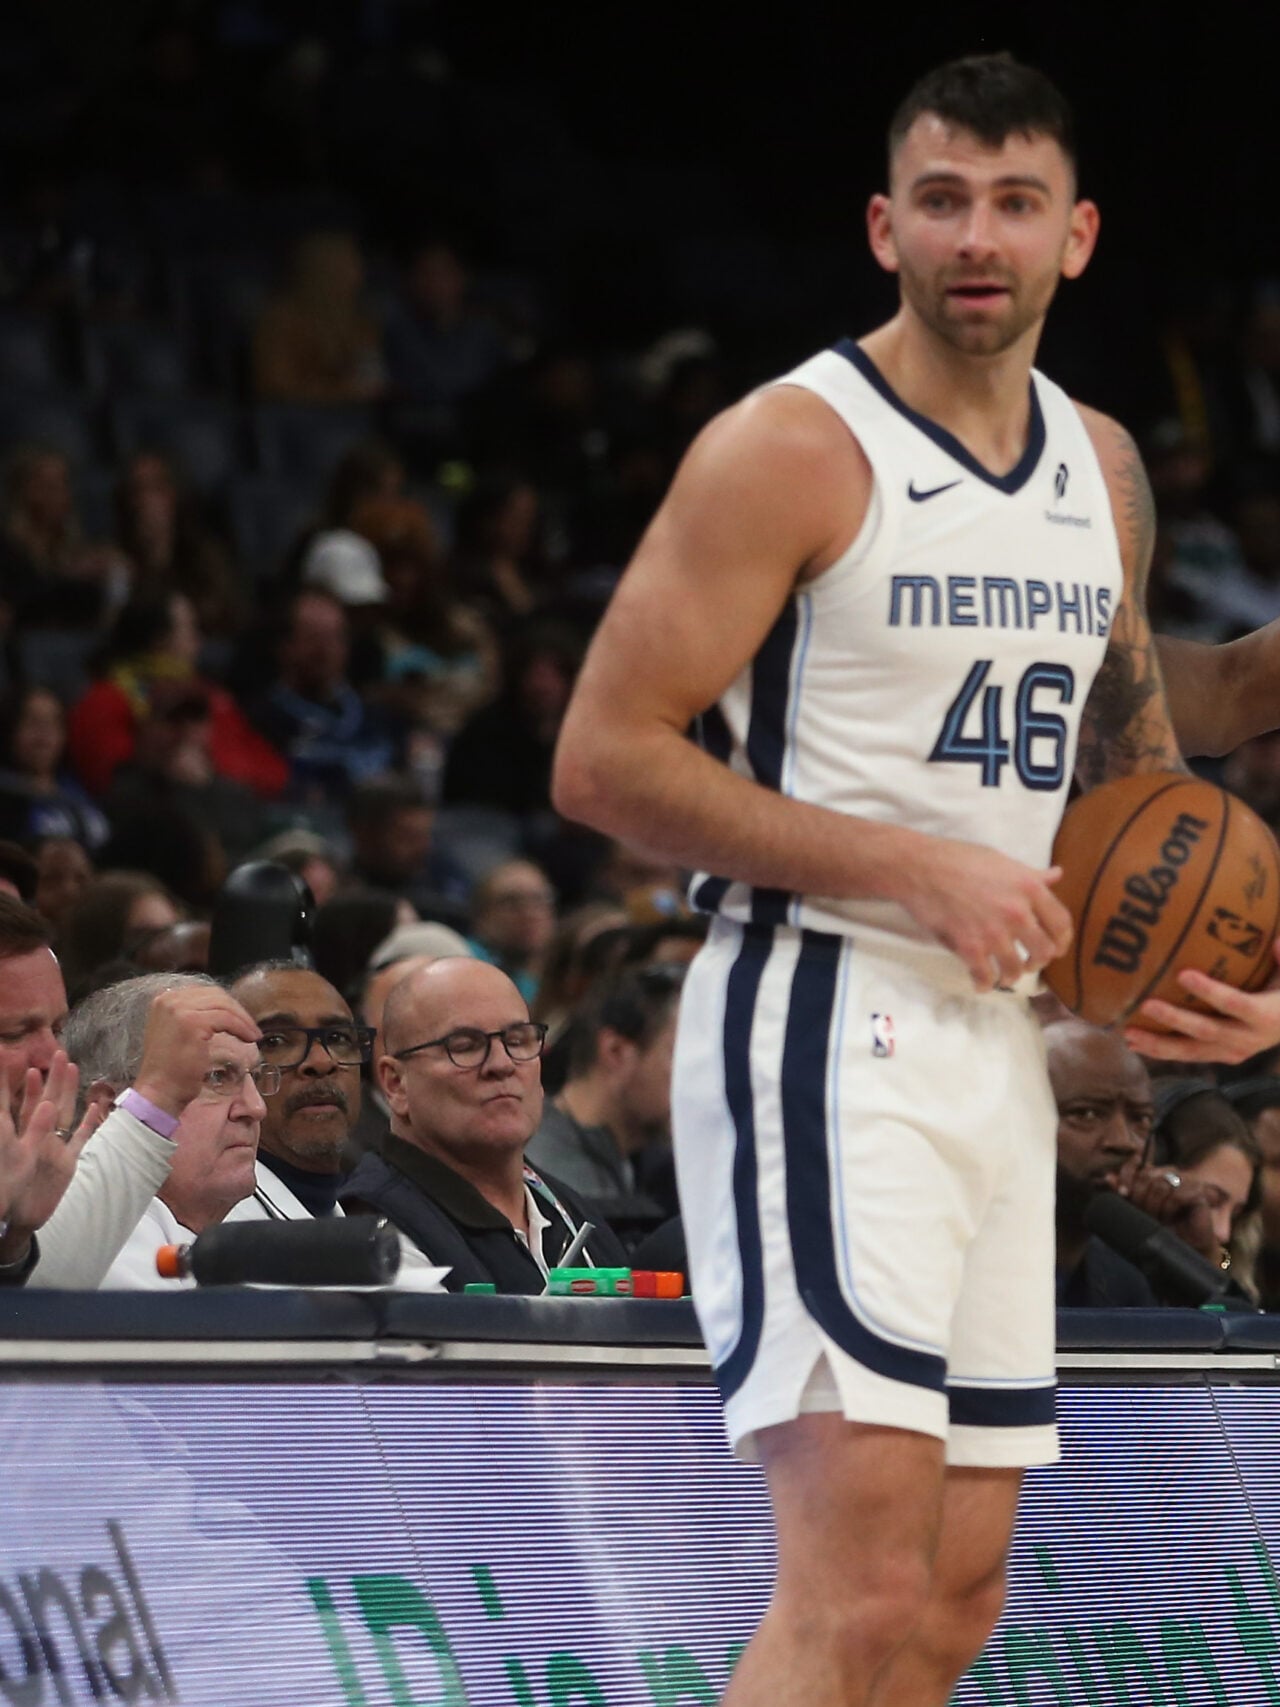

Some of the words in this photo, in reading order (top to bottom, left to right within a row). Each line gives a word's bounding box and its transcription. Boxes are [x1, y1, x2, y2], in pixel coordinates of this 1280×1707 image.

[888, 574, 1111, 637] MEMPHIS
[927, 660, 1074, 792] 46
[1093, 812, 1208, 974] Wilson
